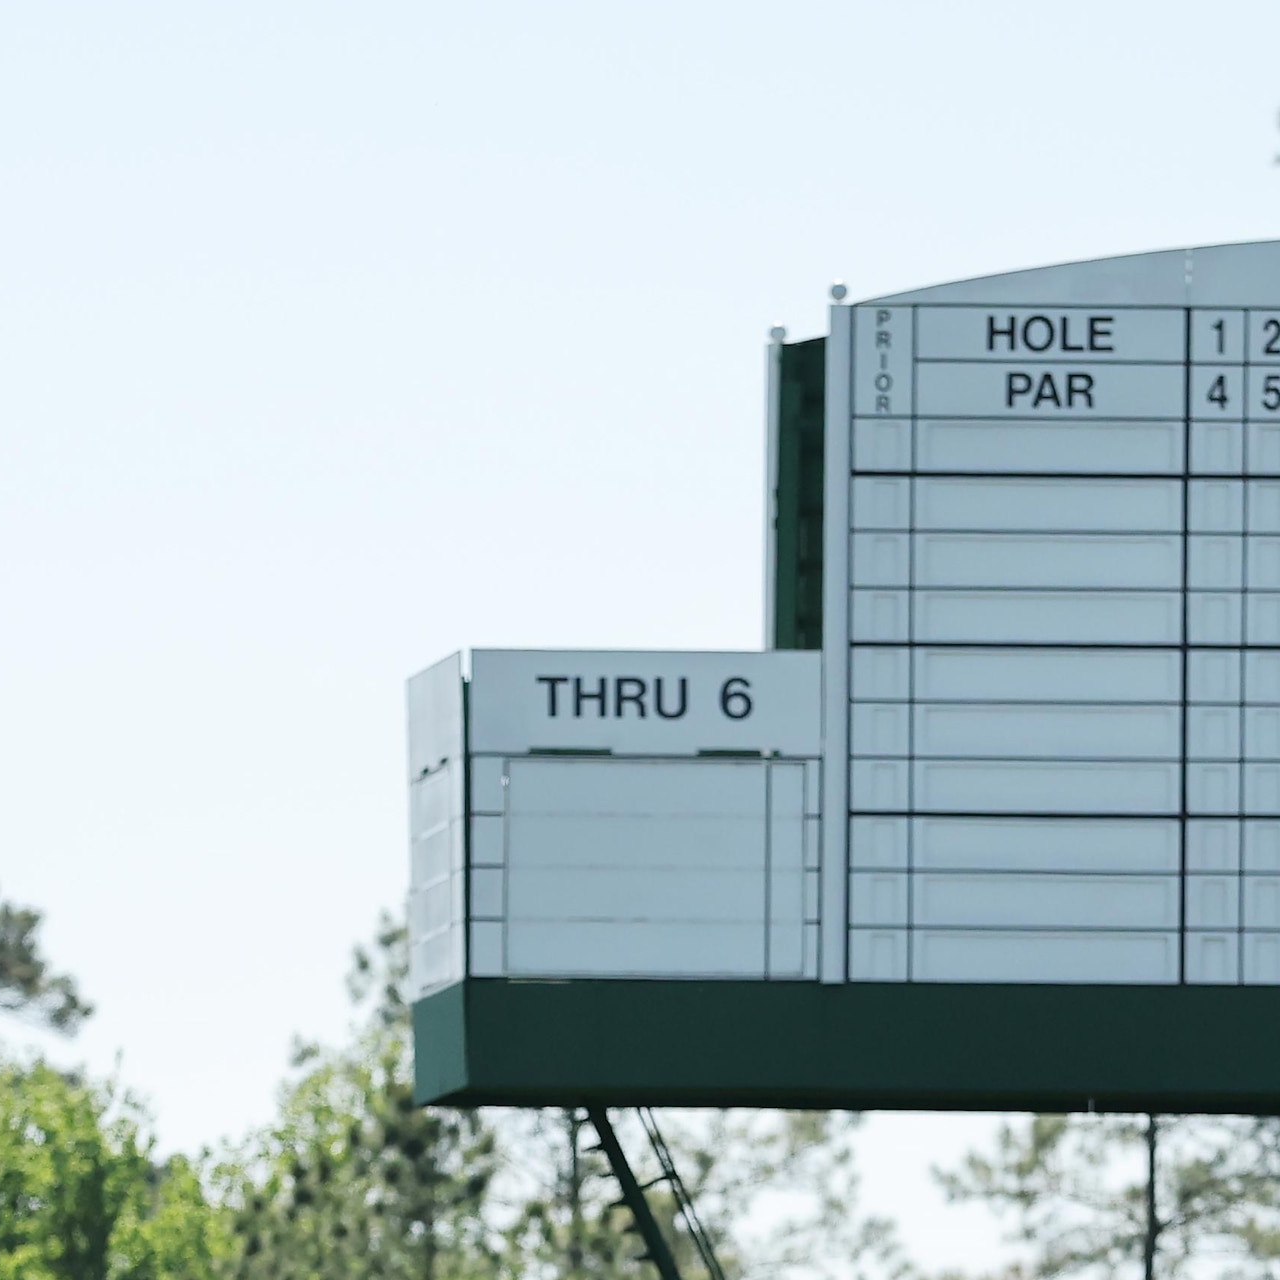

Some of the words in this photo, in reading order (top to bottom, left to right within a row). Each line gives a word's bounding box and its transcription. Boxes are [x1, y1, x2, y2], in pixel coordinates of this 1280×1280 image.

[986, 314, 1115, 353] HOLE
[1213, 319, 1224, 354] 1
[874, 308, 893, 414] PRIOR
[1005, 371, 1095, 409] PAR
[1207, 374, 1229, 409] 4
[535, 675, 688, 721] THRU
[719, 676, 753, 721] 6
